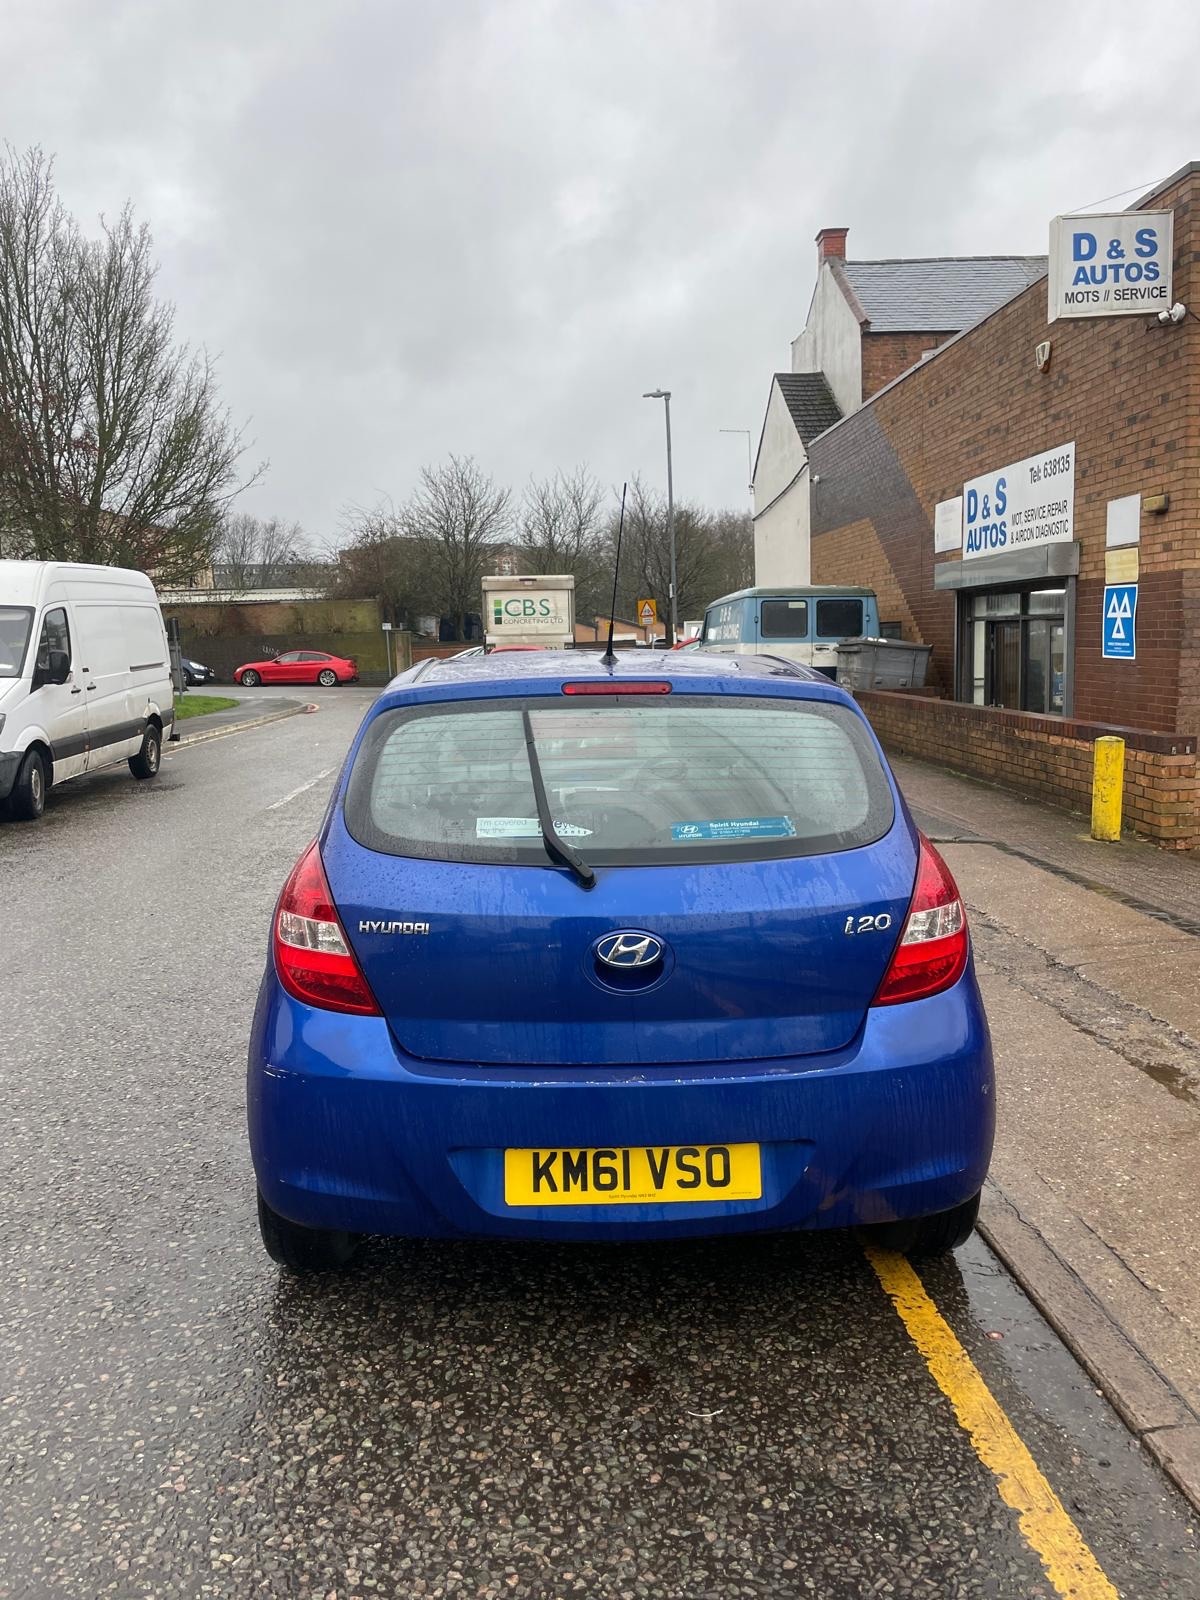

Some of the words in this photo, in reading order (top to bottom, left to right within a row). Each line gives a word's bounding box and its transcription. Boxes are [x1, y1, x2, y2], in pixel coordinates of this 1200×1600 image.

[1072, 232, 1097, 262] D
[1106, 238, 1126, 260] &
[1134, 228, 1158, 258] S
[1072, 261, 1160, 286] AUTOS
[1064, 290, 1100, 304] MOTS
[1113, 286, 1168, 301] SERVICE
[1043, 453, 1070, 479] 638135
[967, 488, 978, 524] D
[981, 494, 991, 520] &
[995, 477, 1007, 516] S
[966, 520, 1007, 553] AUTOS
[1015, 526, 1035, 544] AIRCON
[1035, 518, 1069, 540] DIAGNOSTIC
[504, 598, 551, 617] CBS
[503, 617, 549, 625] CONCRETING
[550, 616, 564, 625] LTD
[730, 820, 760, 828] Hyundai
[359, 920, 430, 935] HYUNDAI
[844, 913, 892, 935] i20
[532, 1149, 631, 1193] KM61
[645, 1146, 731, 1190] VSO
